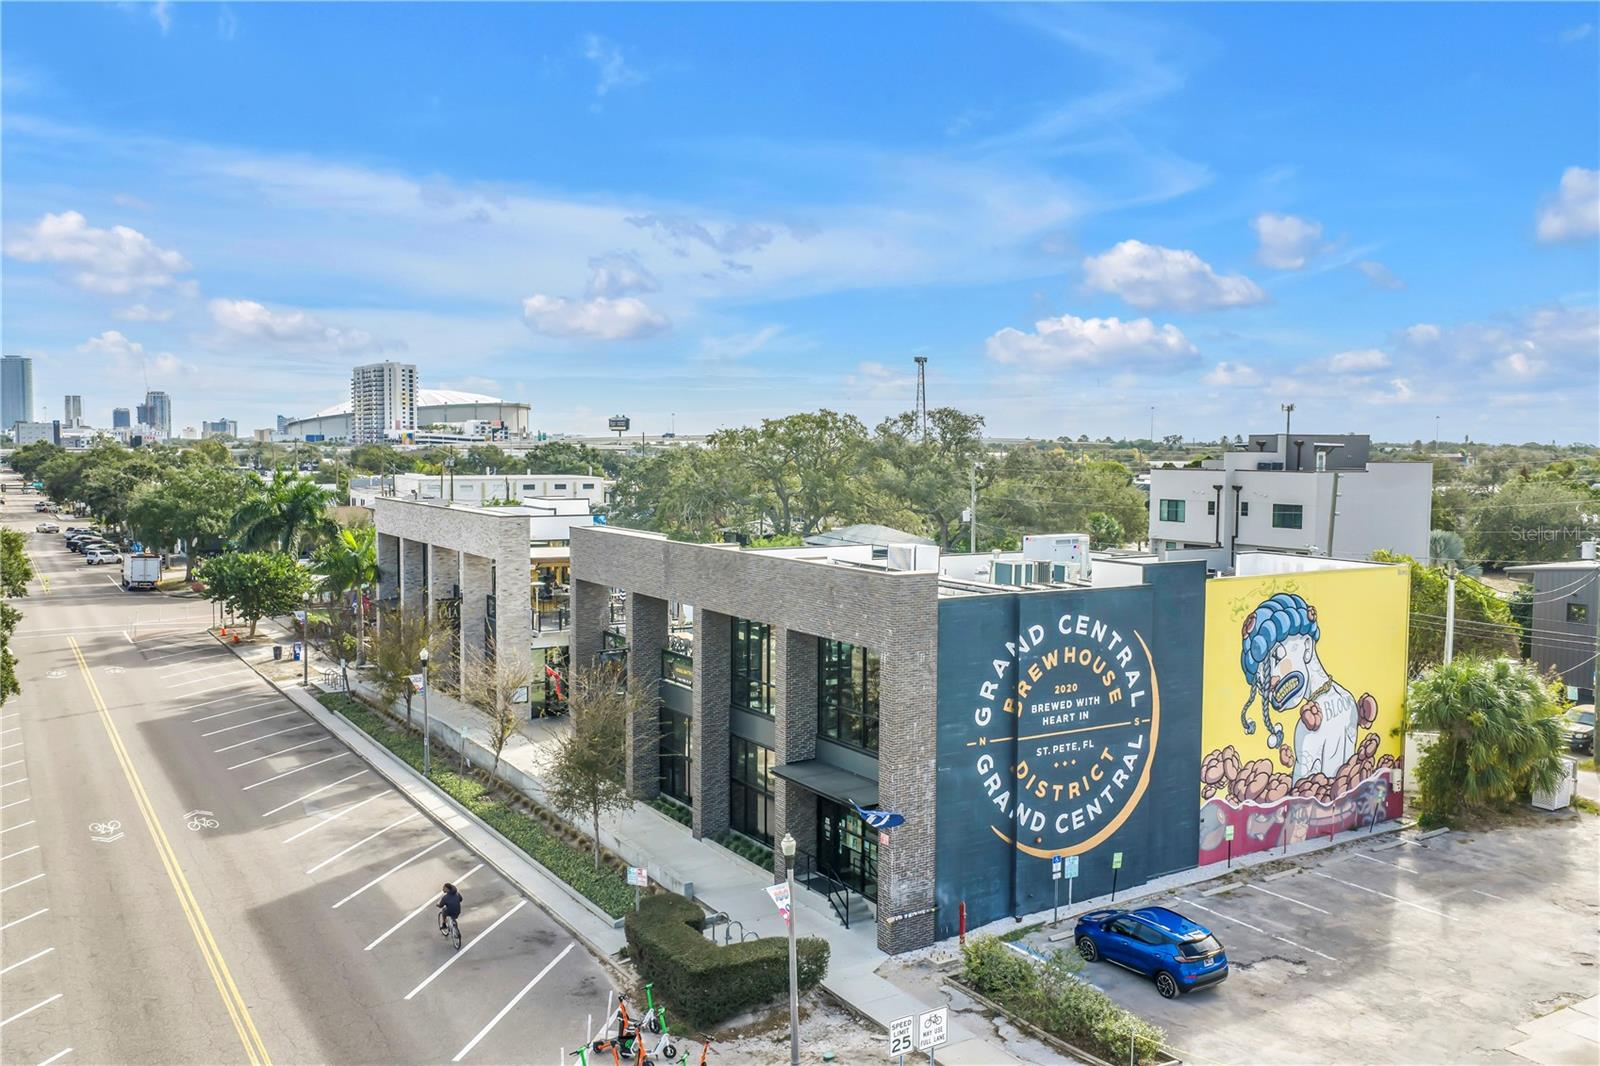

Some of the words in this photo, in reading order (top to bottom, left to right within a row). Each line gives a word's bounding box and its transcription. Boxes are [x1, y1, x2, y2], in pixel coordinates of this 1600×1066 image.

[975, 624, 1045, 727] GRAND
[1058, 614, 1145, 708] CENTRAL
[1003, 646, 1122, 718] BREWHOUSE
[1054, 683, 1078, 694] 2020
[1031, 699, 1073, 714] BREWED
[1076, 695, 1100, 708] WITH
[1042, 712, 1076, 726] HEART
[1079, 710, 1089, 720] IN
[1134, 717, 1141, 726] S
[979, 736, 987, 746] N
[1036, 746, 1051, 757] ST.
[1052, 741, 1081, 754] PETE,
[1083, 739, 1095, 749] FL
[1014, 747, 1115, 802] DISTRICT
[976, 754, 1046, 832] GRAND
[1055, 734, 1143, 834] CENTRAL
[892, 1020, 911, 1030] SPEED
[893, 1027, 909, 1038] LIMIT
[892, 1035, 911, 1053] 25
